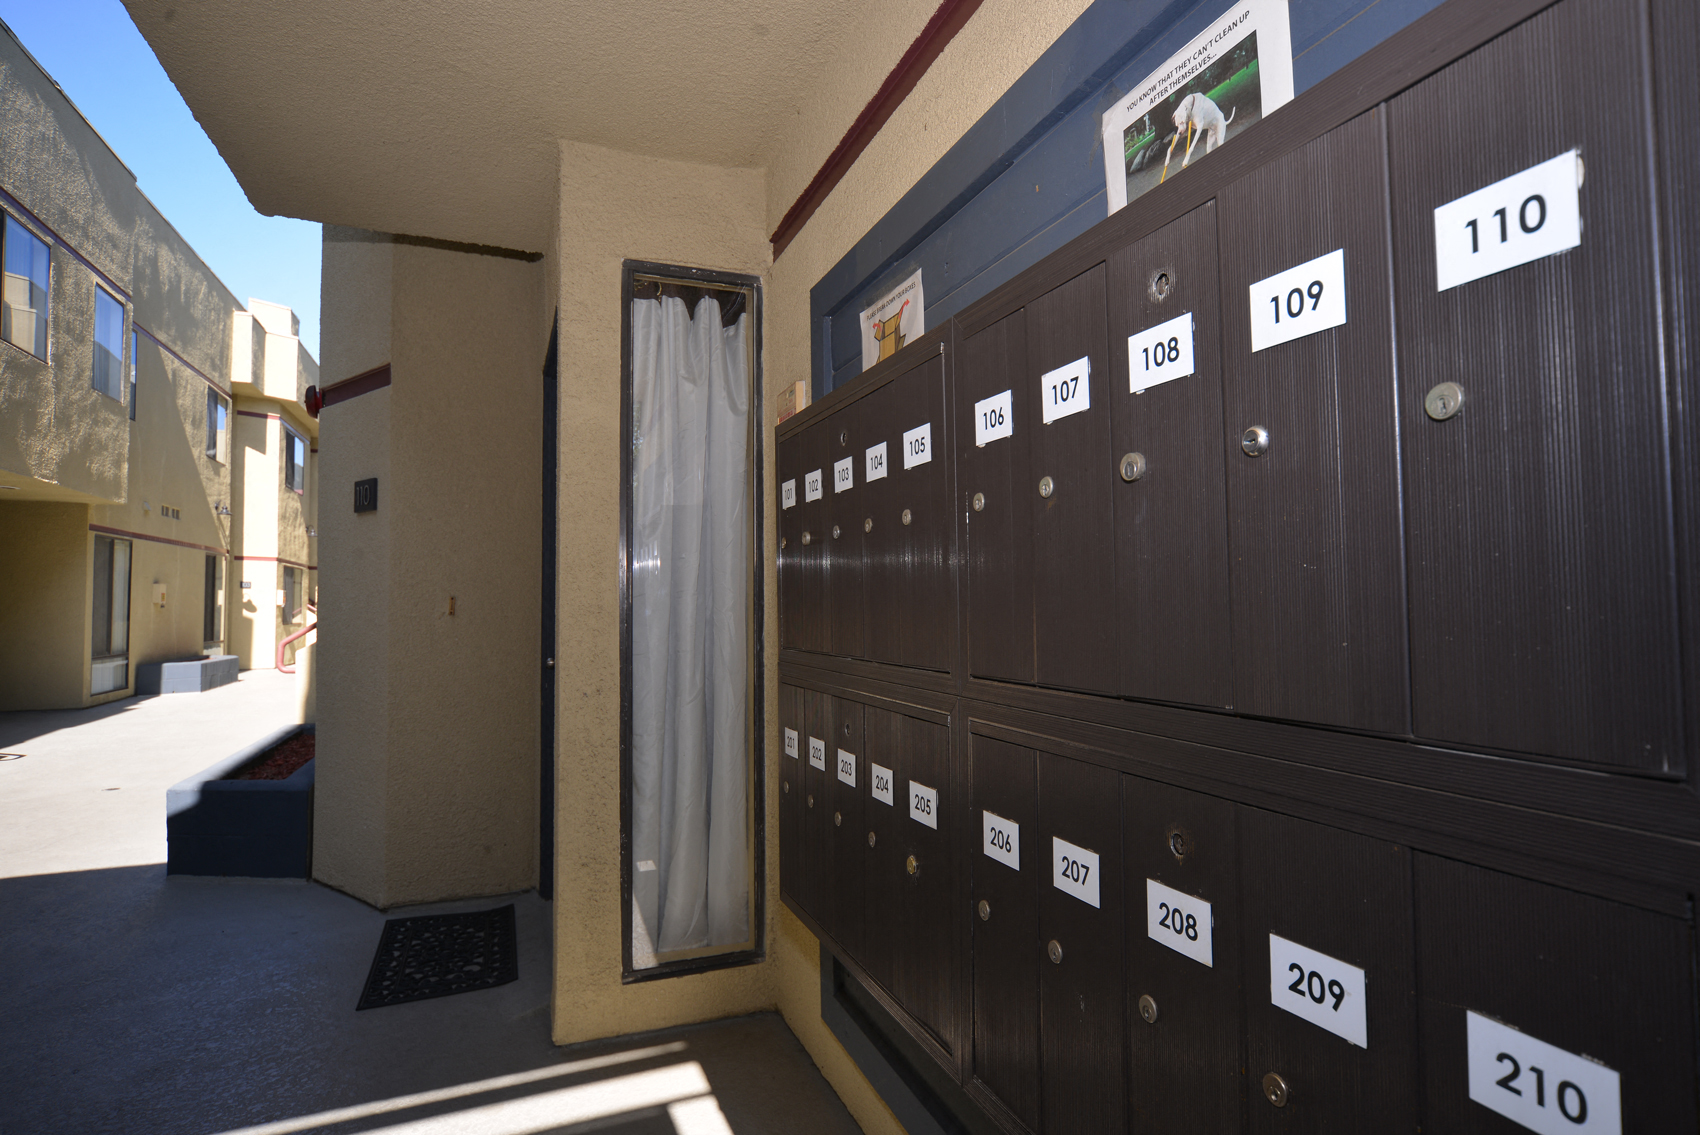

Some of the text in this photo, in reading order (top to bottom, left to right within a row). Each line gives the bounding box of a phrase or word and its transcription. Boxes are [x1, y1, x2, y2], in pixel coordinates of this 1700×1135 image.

[1126, 9, 1250, 113] YOU KNOW THAT THEY CAN'T CLEAN UP
[1149, 86, 1169, 106] AFTER
[1464, 194, 1548, 255] 110
[1270, 280, 1325, 325] 109
[1141, 336, 1181, 372] 108
[1051, 376, 1080, 406] 107
[982, 406, 1005, 431] 106
[909, 436, 926, 457] 105
[870, 453, 883, 471] 104
[808, 478, 819, 494] 102
[838, 467, 850, 483] 103
[356, 484, 370, 506] 110
[784, 487, 793, 497] 101
[786, 735, 795, 750] 201
[812, 745, 822, 762] 202
[840, 759, 853, 777] 203
[875, 774, 889, 794] 204
[914, 793, 932, 816] 205
[990, 826, 1012, 854] 206
[1061, 855, 1090, 887] 207
[1158, 902, 1199, 942] 208
[1287, 962, 1346, 1013] 209
[1495, 1051, 1589, 1126] 210
